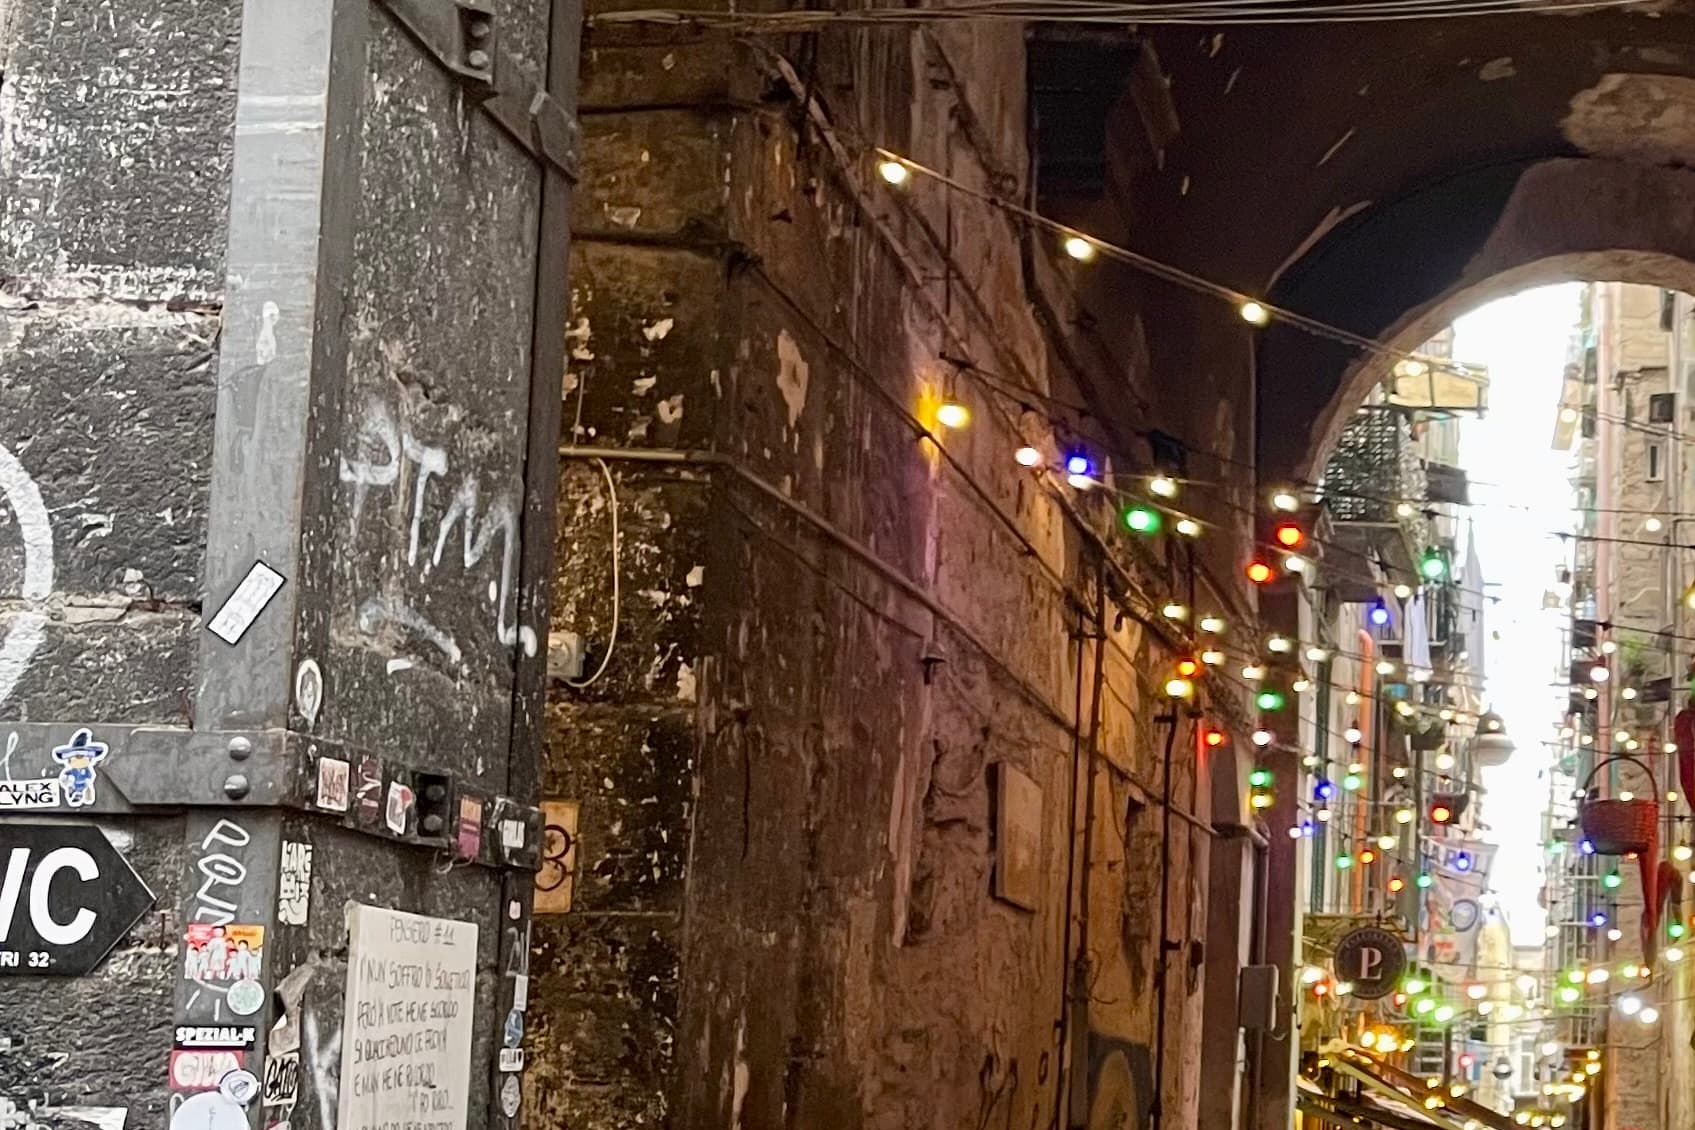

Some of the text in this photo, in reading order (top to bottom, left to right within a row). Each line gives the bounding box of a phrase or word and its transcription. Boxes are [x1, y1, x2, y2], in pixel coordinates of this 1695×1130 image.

[0, 848, 100, 945] C
[0, 951, 50, 967] RI 32
[175, 1026, 255, 1042] SPEZIAL-K
